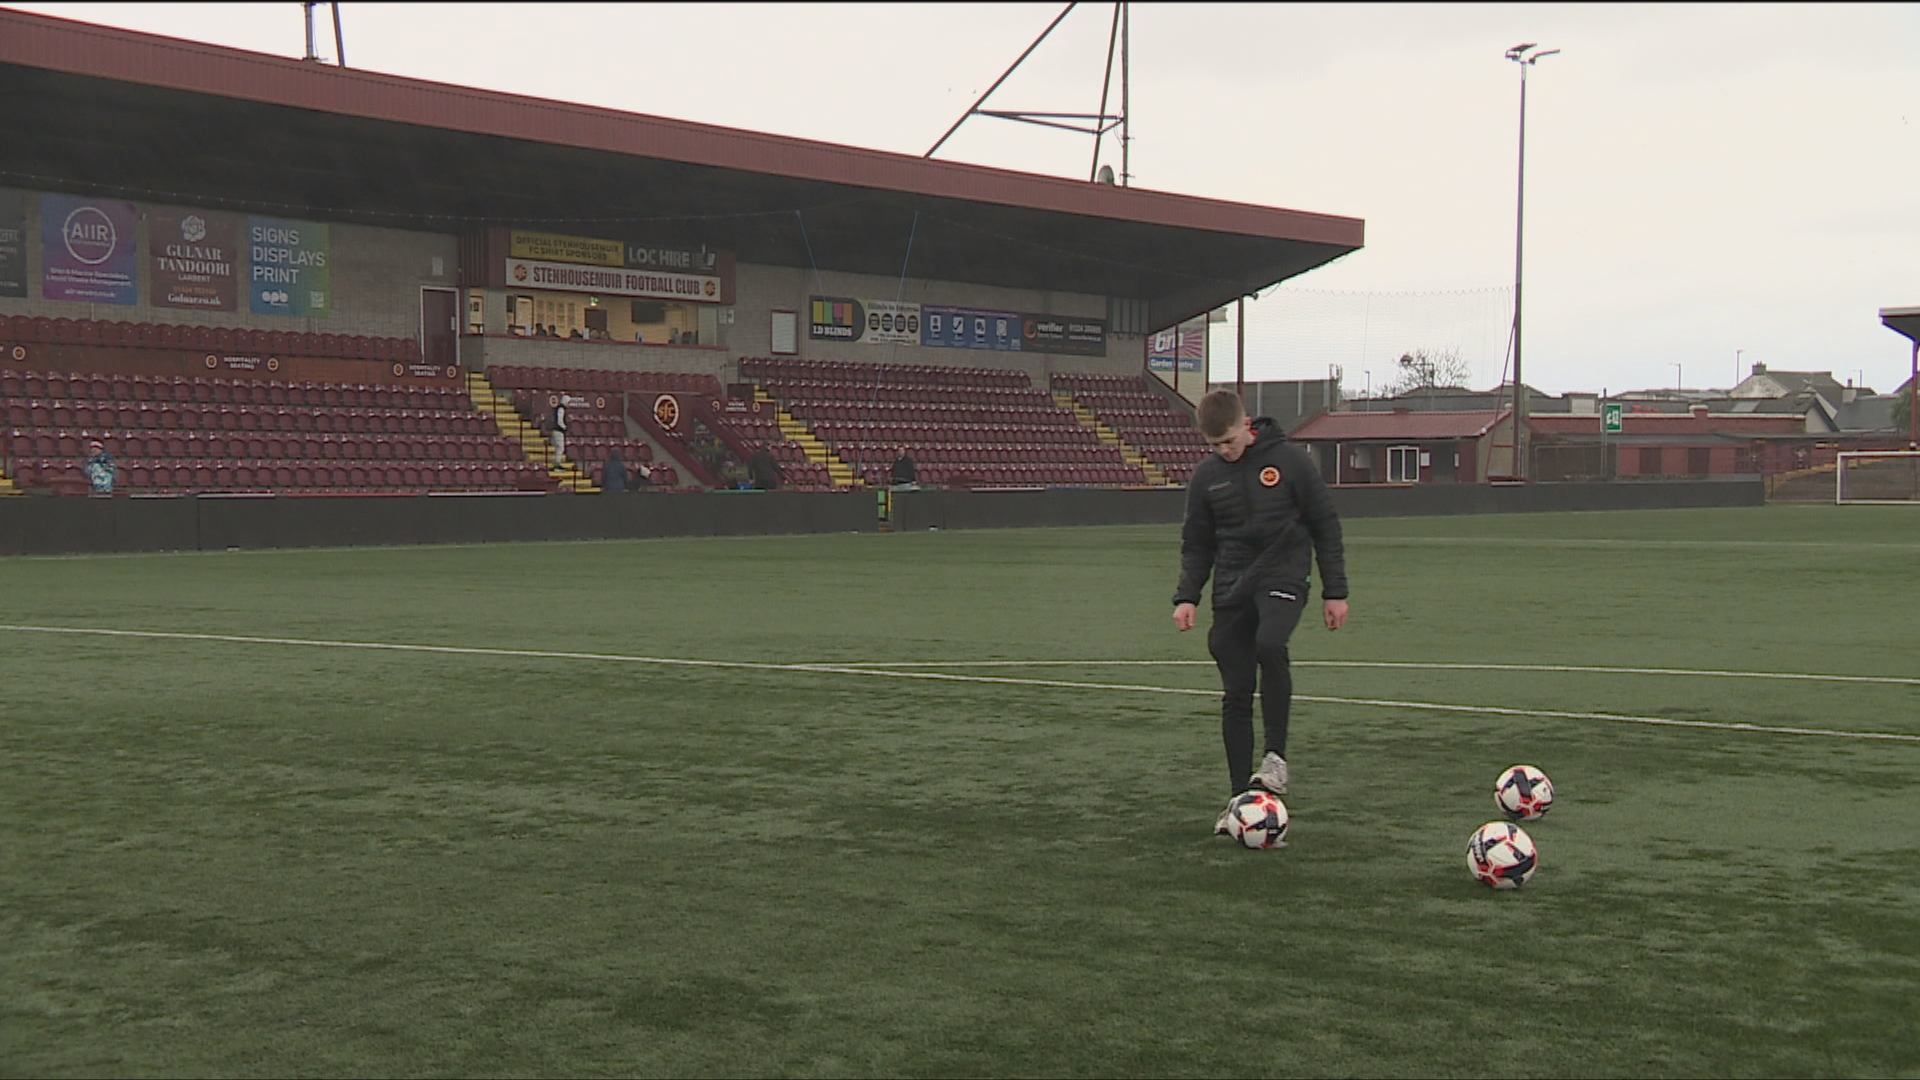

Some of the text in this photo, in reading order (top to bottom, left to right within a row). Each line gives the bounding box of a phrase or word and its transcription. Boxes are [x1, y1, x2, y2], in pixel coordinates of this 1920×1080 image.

[71, 222, 109, 241] AIIR
[252, 226, 299, 245] SIGNS
[166, 244, 222, 261] GULNAR
[516, 235, 618, 253] OFFICIAL STENHOUSEMUIR
[528, 245, 608, 261] FC SHIRT SPONSORS
[252, 246, 326, 267] DISPLAYS
[628, 247, 690, 268] LOC HIRE
[157, 257, 230, 276] TANDOORI
[253, 266, 300, 284] PRINT
[533, 266, 700, 295] STENHOUSEMUIR FOOTBALL CLUB
[825, 326, 853, 337] BLINDS
